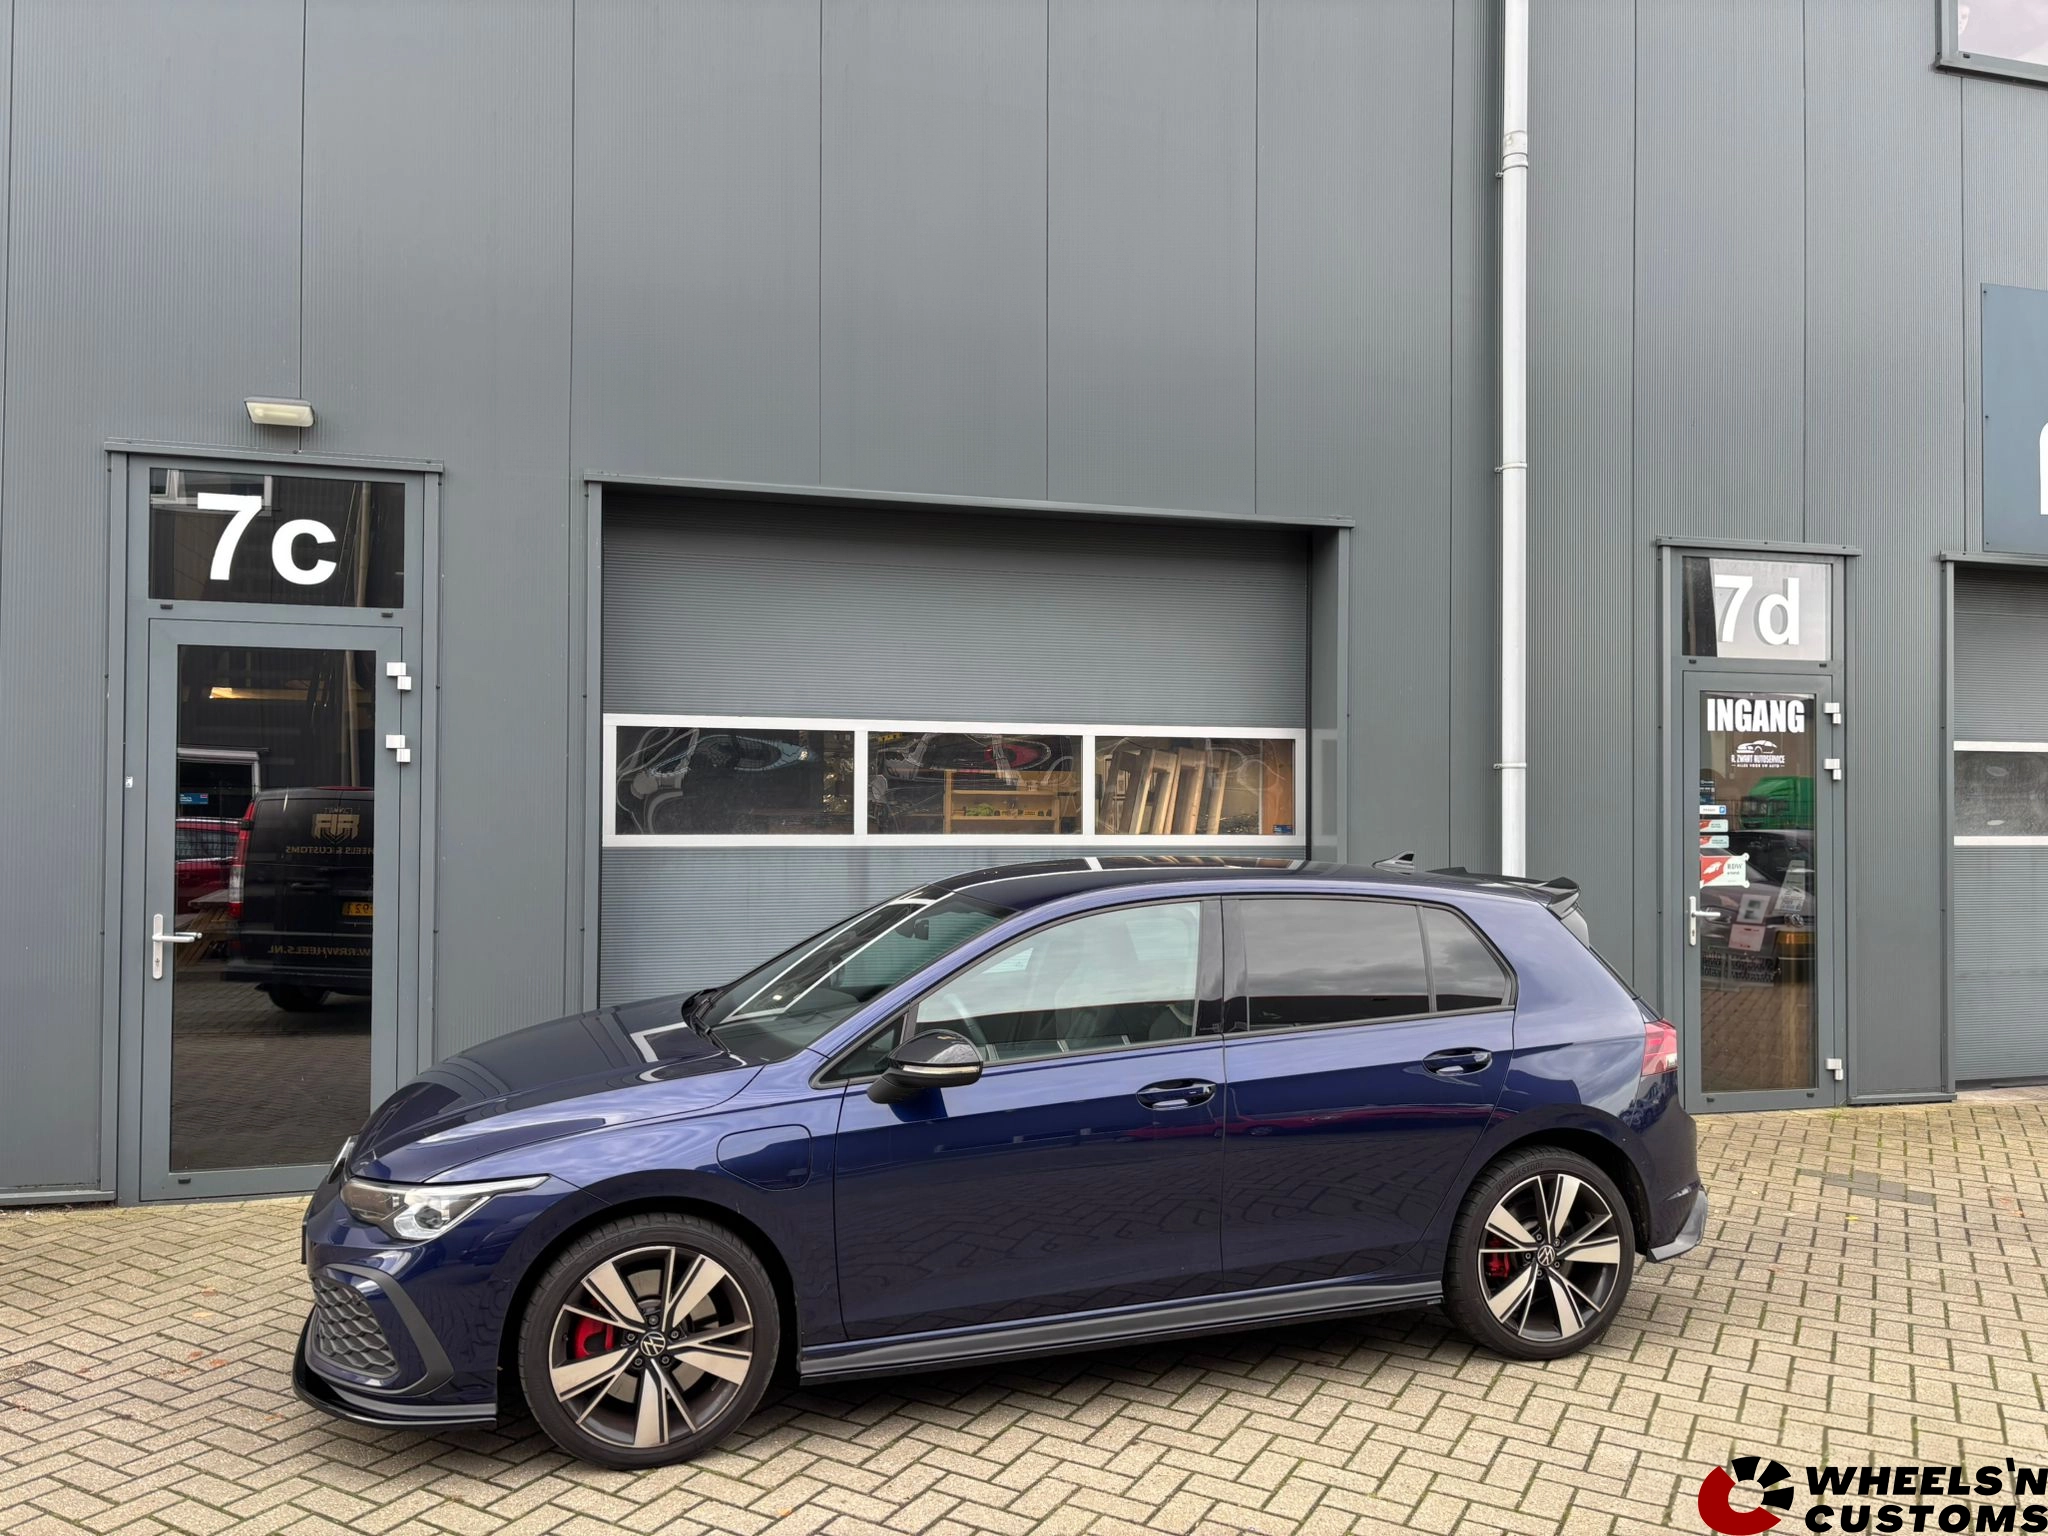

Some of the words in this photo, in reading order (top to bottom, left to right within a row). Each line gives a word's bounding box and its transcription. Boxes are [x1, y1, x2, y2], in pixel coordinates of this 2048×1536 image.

[197, 492, 337, 586] 7c
[1713, 573, 1801, 645] 7d
[1707, 698, 1805, 733] INGANG
[1754, 754, 1785, 764] AUTOSERVICE
